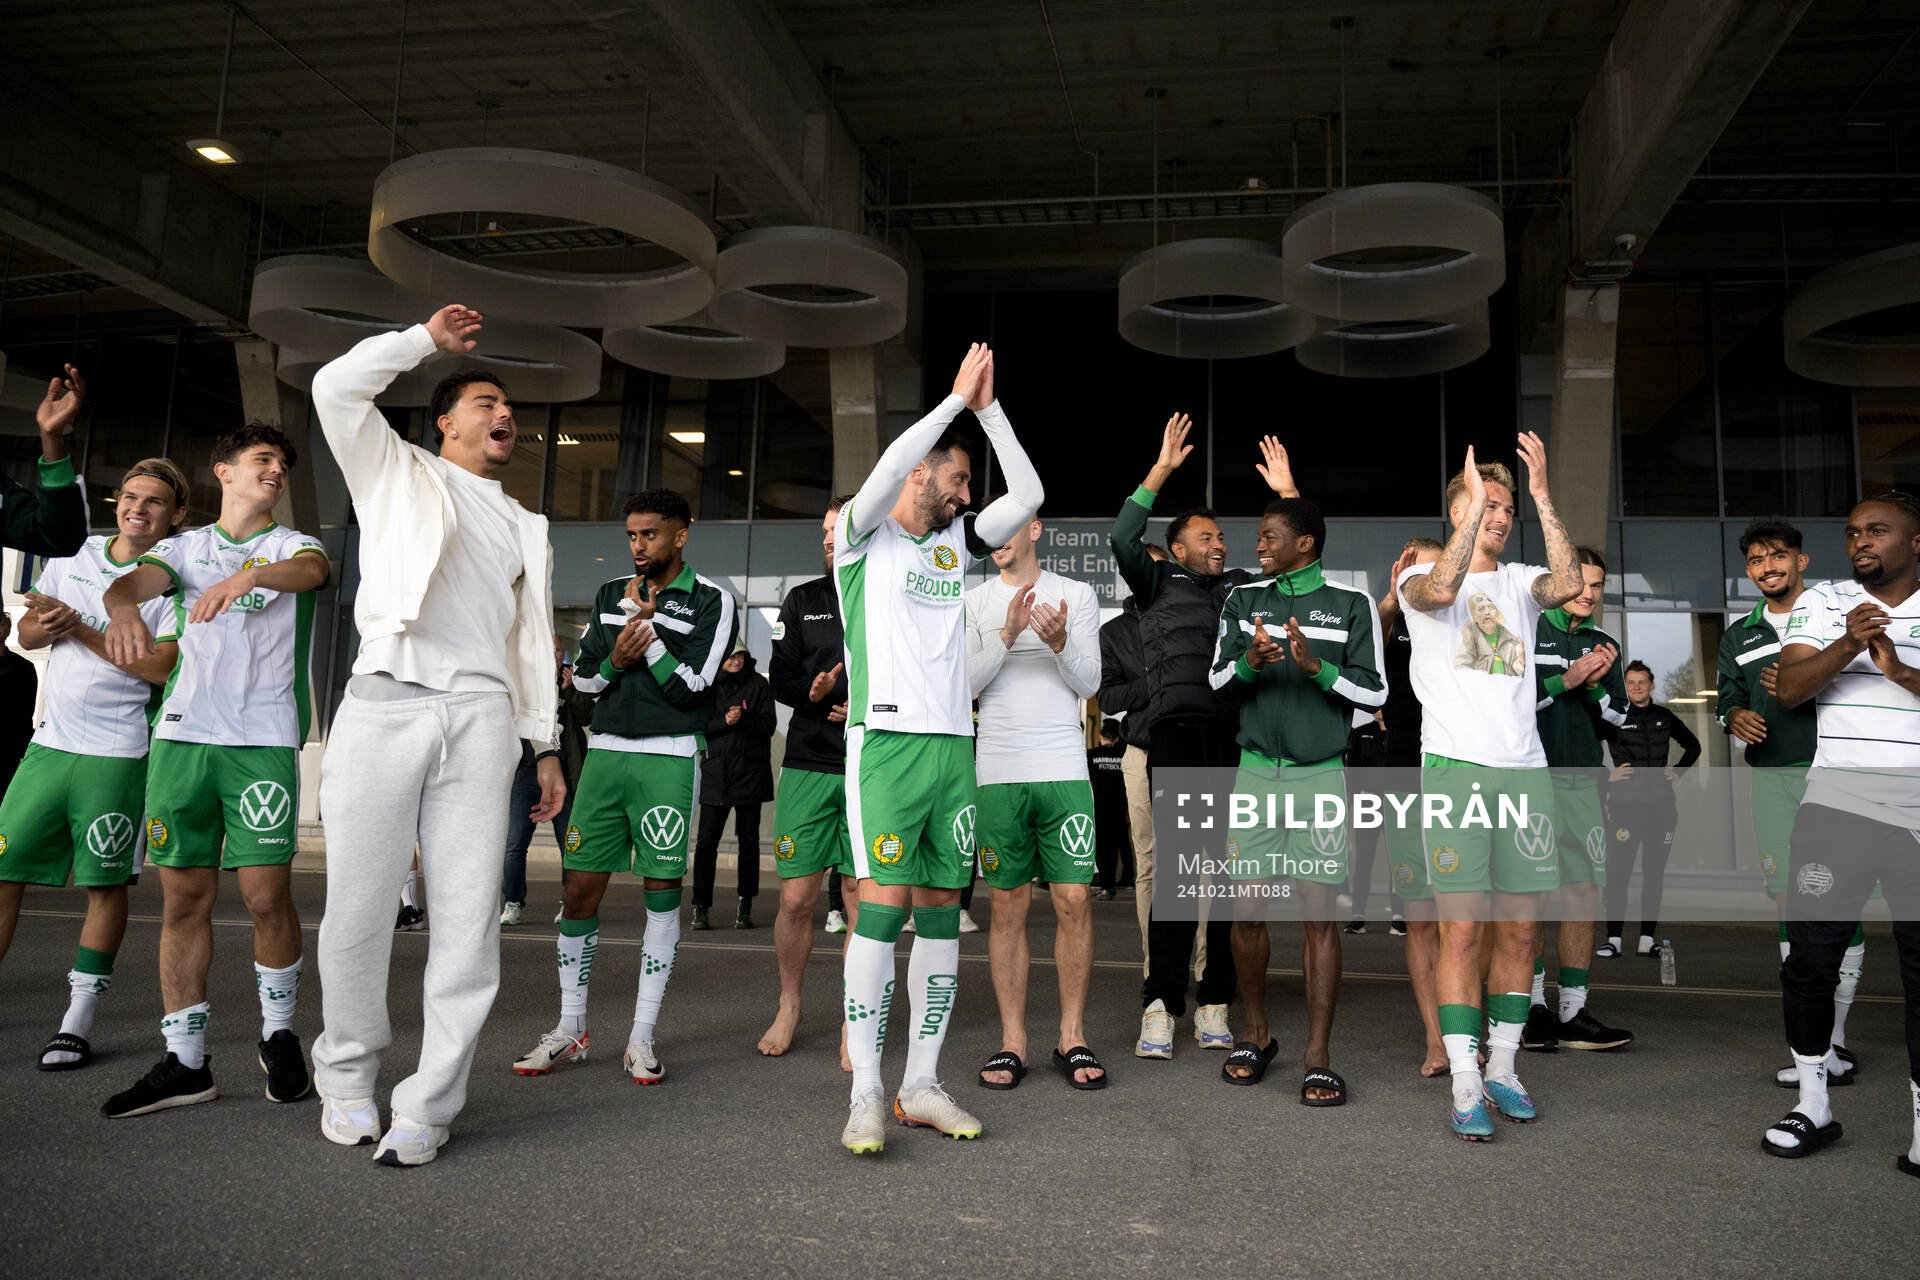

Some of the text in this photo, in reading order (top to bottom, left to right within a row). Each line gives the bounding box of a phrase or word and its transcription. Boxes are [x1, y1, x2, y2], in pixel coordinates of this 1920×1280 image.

[1045, 528, 1099, 547] Team
[1038, 554, 1118, 573] rtist Ent
[906, 570, 961, 597] PROJOB
[237, 592, 266, 610] OB
[664, 600, 695, 616] Bajen
[1310, 610, 1342, 626] Bajen
[1790, 616, 1810, 624] BET
[920, 974, 958, 1036] Clinton
[1070, 1054, 1093, 1063] CRAFT
[1230, 1049, 1252, 1058] CRAFT
[1304, 1074, 1334, 1083] CRAFT
